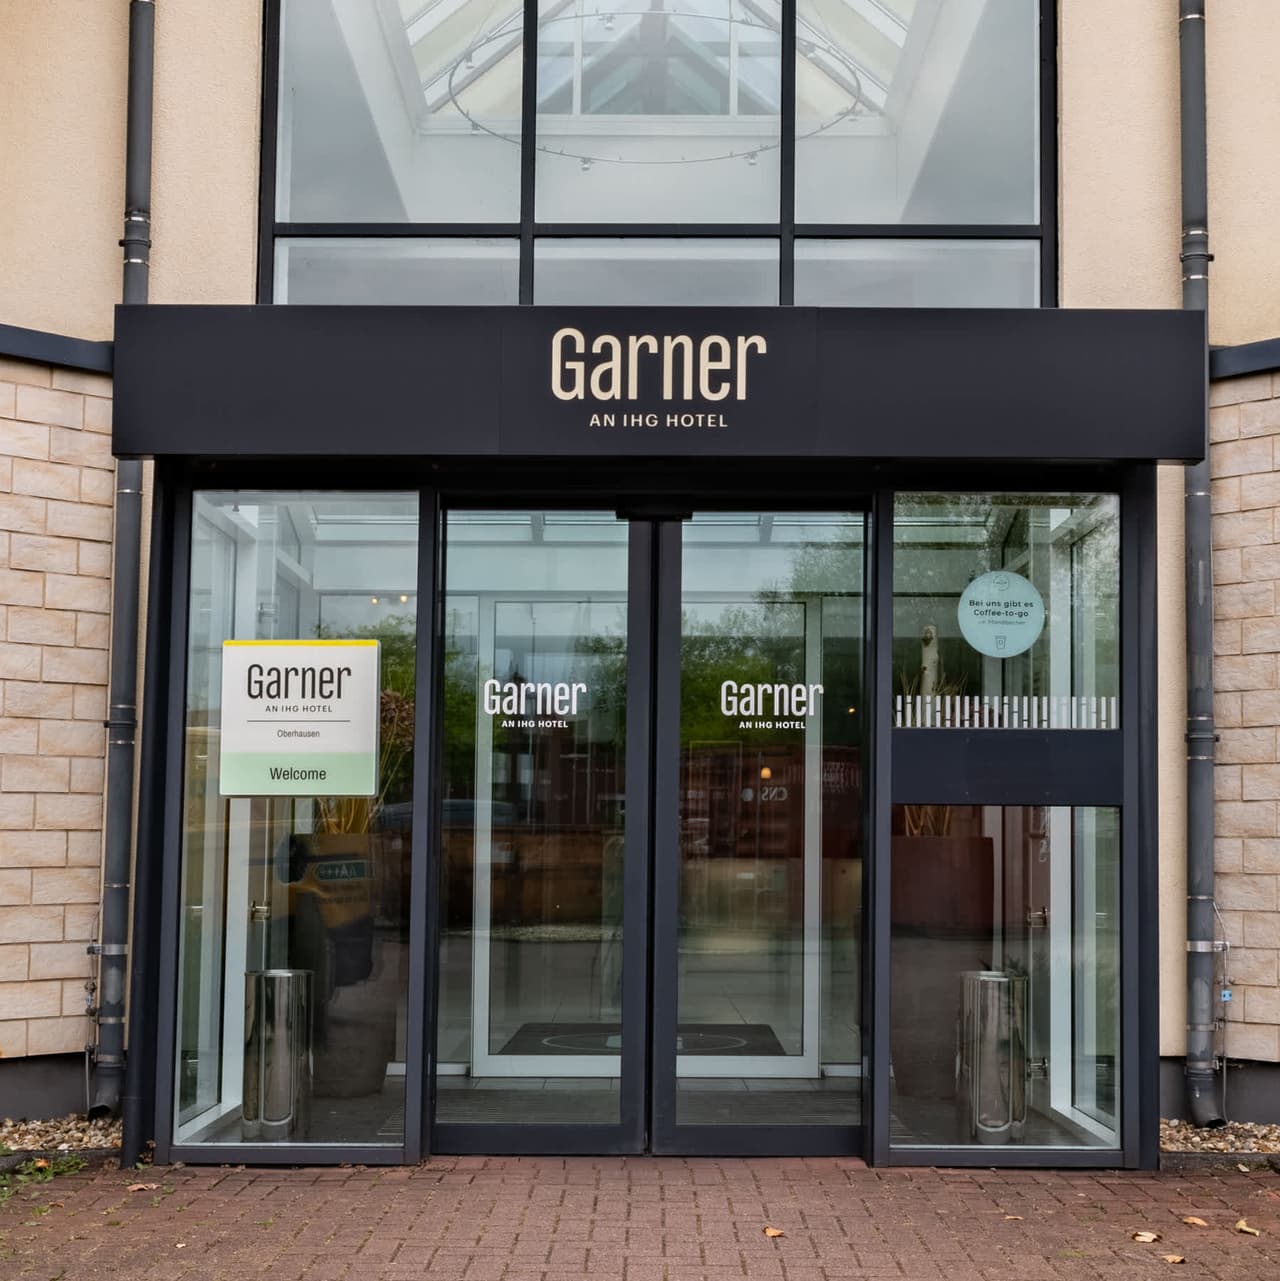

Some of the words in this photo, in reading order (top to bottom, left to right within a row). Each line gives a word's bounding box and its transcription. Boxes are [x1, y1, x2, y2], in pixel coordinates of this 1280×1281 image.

[551, 327, 767, 401] Garner
[589, 414, 615, 427] AN
[623, 414, 659, 427] IHG
[666, 414, 728, 427] HOTEL
[1004, 600, 1022, 608] gibt
[973, 609, 1029, 618] Coffee-to-go
[247, 663, 352, 699] Garner
[483, 678, 587, 715] Garner
[721, 679, 824, 716] Garner
[265, 705, 278, 713] AN
[281, 705, 299, 713] IHG
[302, 705, 333, 713] HOTEL
[501, 720, 515, 728] AN
[518, 720, 535, 728] IHG
[538, 720, 568, 728] HOTEL
[739, 721, 752, 729] AN
[755, 721, 773, 729] IHG
[775, 721, 806, 729] HOTEL
[277, 729, 320, 738] Oberhausen
[270, 767, 327, 780] Welcome
